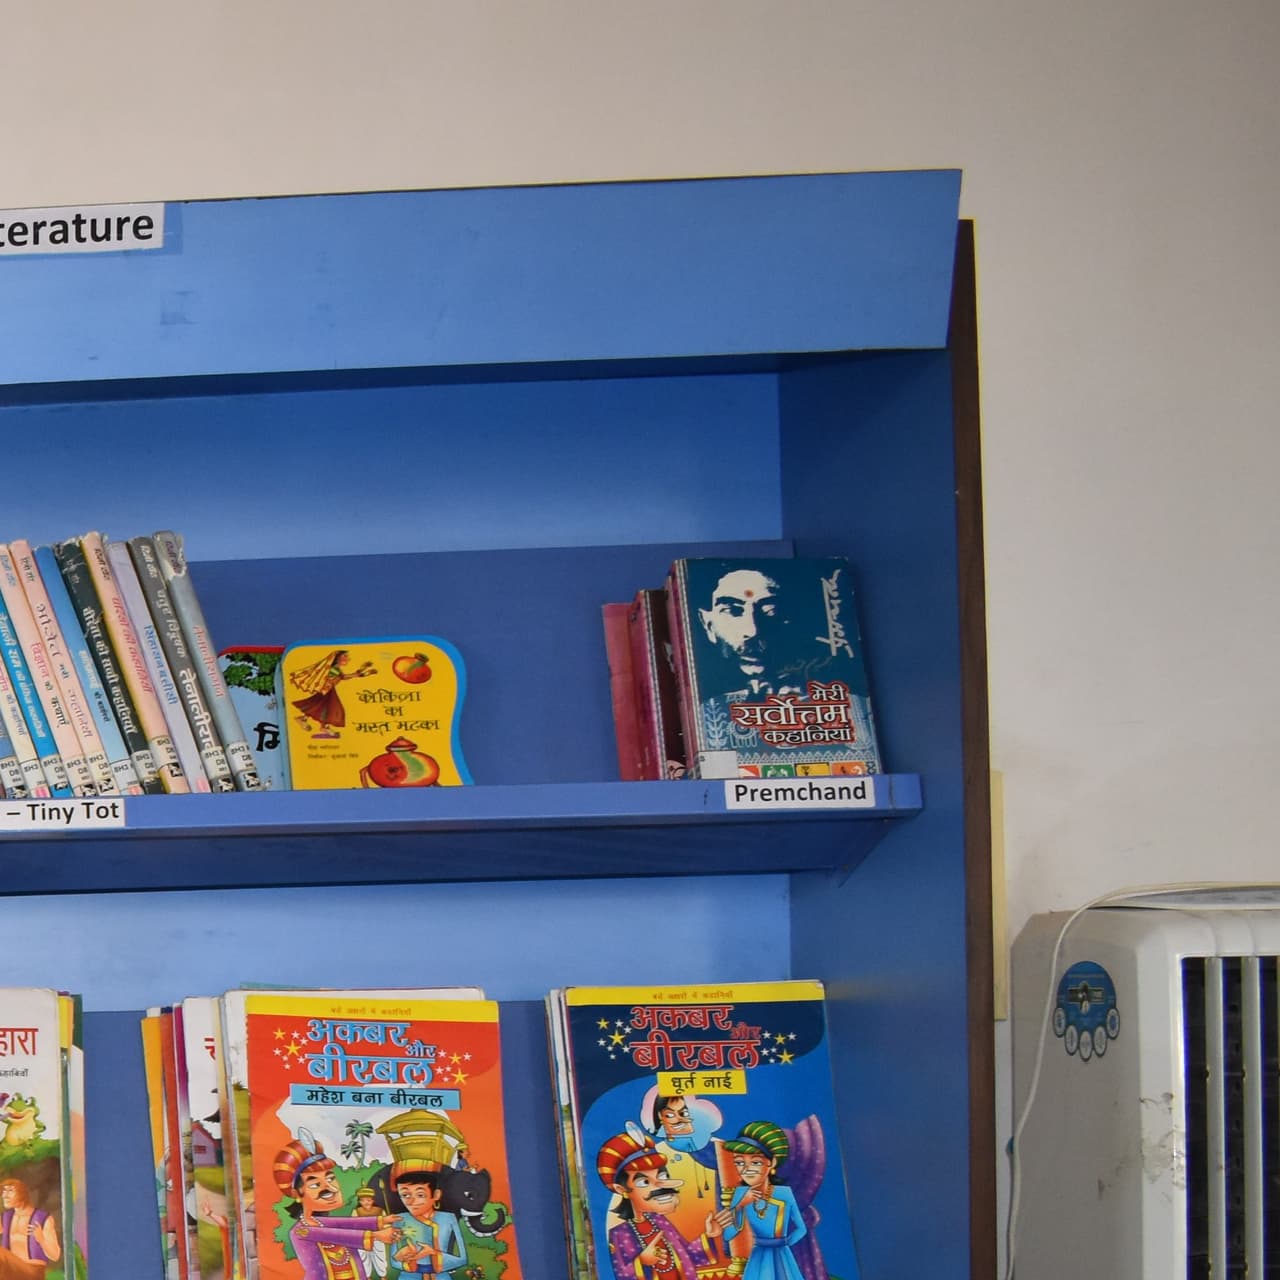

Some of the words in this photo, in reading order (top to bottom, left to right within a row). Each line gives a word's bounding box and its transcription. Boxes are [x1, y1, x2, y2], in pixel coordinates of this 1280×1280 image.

[812, 683, 847, 702] मेरी
[732, 696, 850, 726] सर्वोत्तम
[735, 781, 866, 802] Premchand
[27, 805, 75, 825] Tiny
[82, 803, 119, 819] Tot
[629, 1005, 735, 1031] अकबर
[307, 1019, 412, 1047] अकबर
[629, 1030, 762, 1070] बीरबल
[304, 1042, 437, 1088] बीरबल
[670, 1073, 697, 1095] धूर्त
[703, 1072, 733, 1090] नाई
[306, 1087, 345, 1105] महेश
[351, 1089, 383, 1105] बना
[390, 1086, 444, 1107] बीरबल
